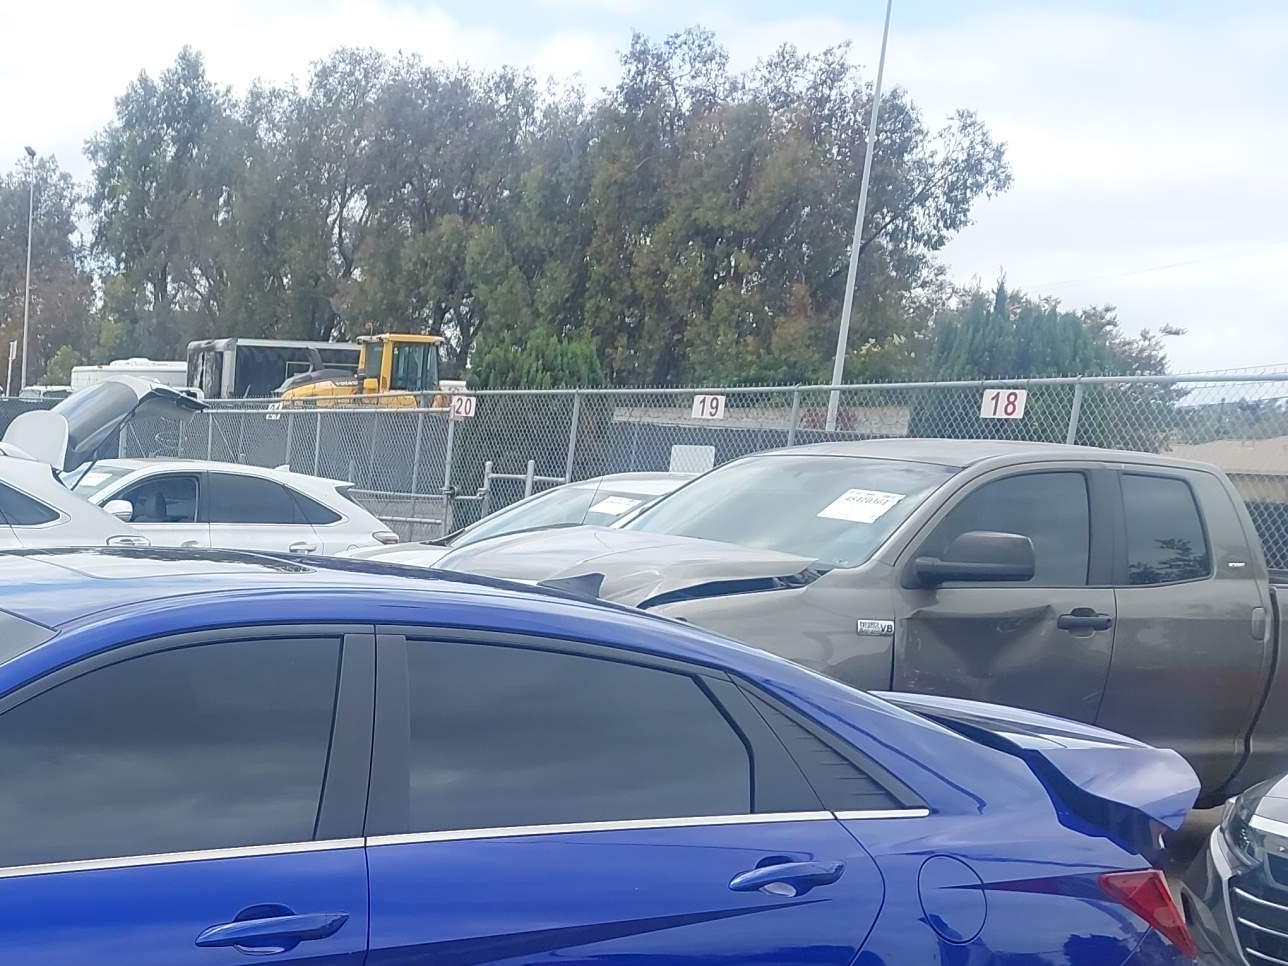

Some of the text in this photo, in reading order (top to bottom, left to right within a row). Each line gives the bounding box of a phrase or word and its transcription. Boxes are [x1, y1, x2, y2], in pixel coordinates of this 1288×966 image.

[455, 397, 472, 415] 20
[699, 396, 719, 417] 19
[991, 391, 1018, 416] 18
[881, 623, 893, 633] V8
